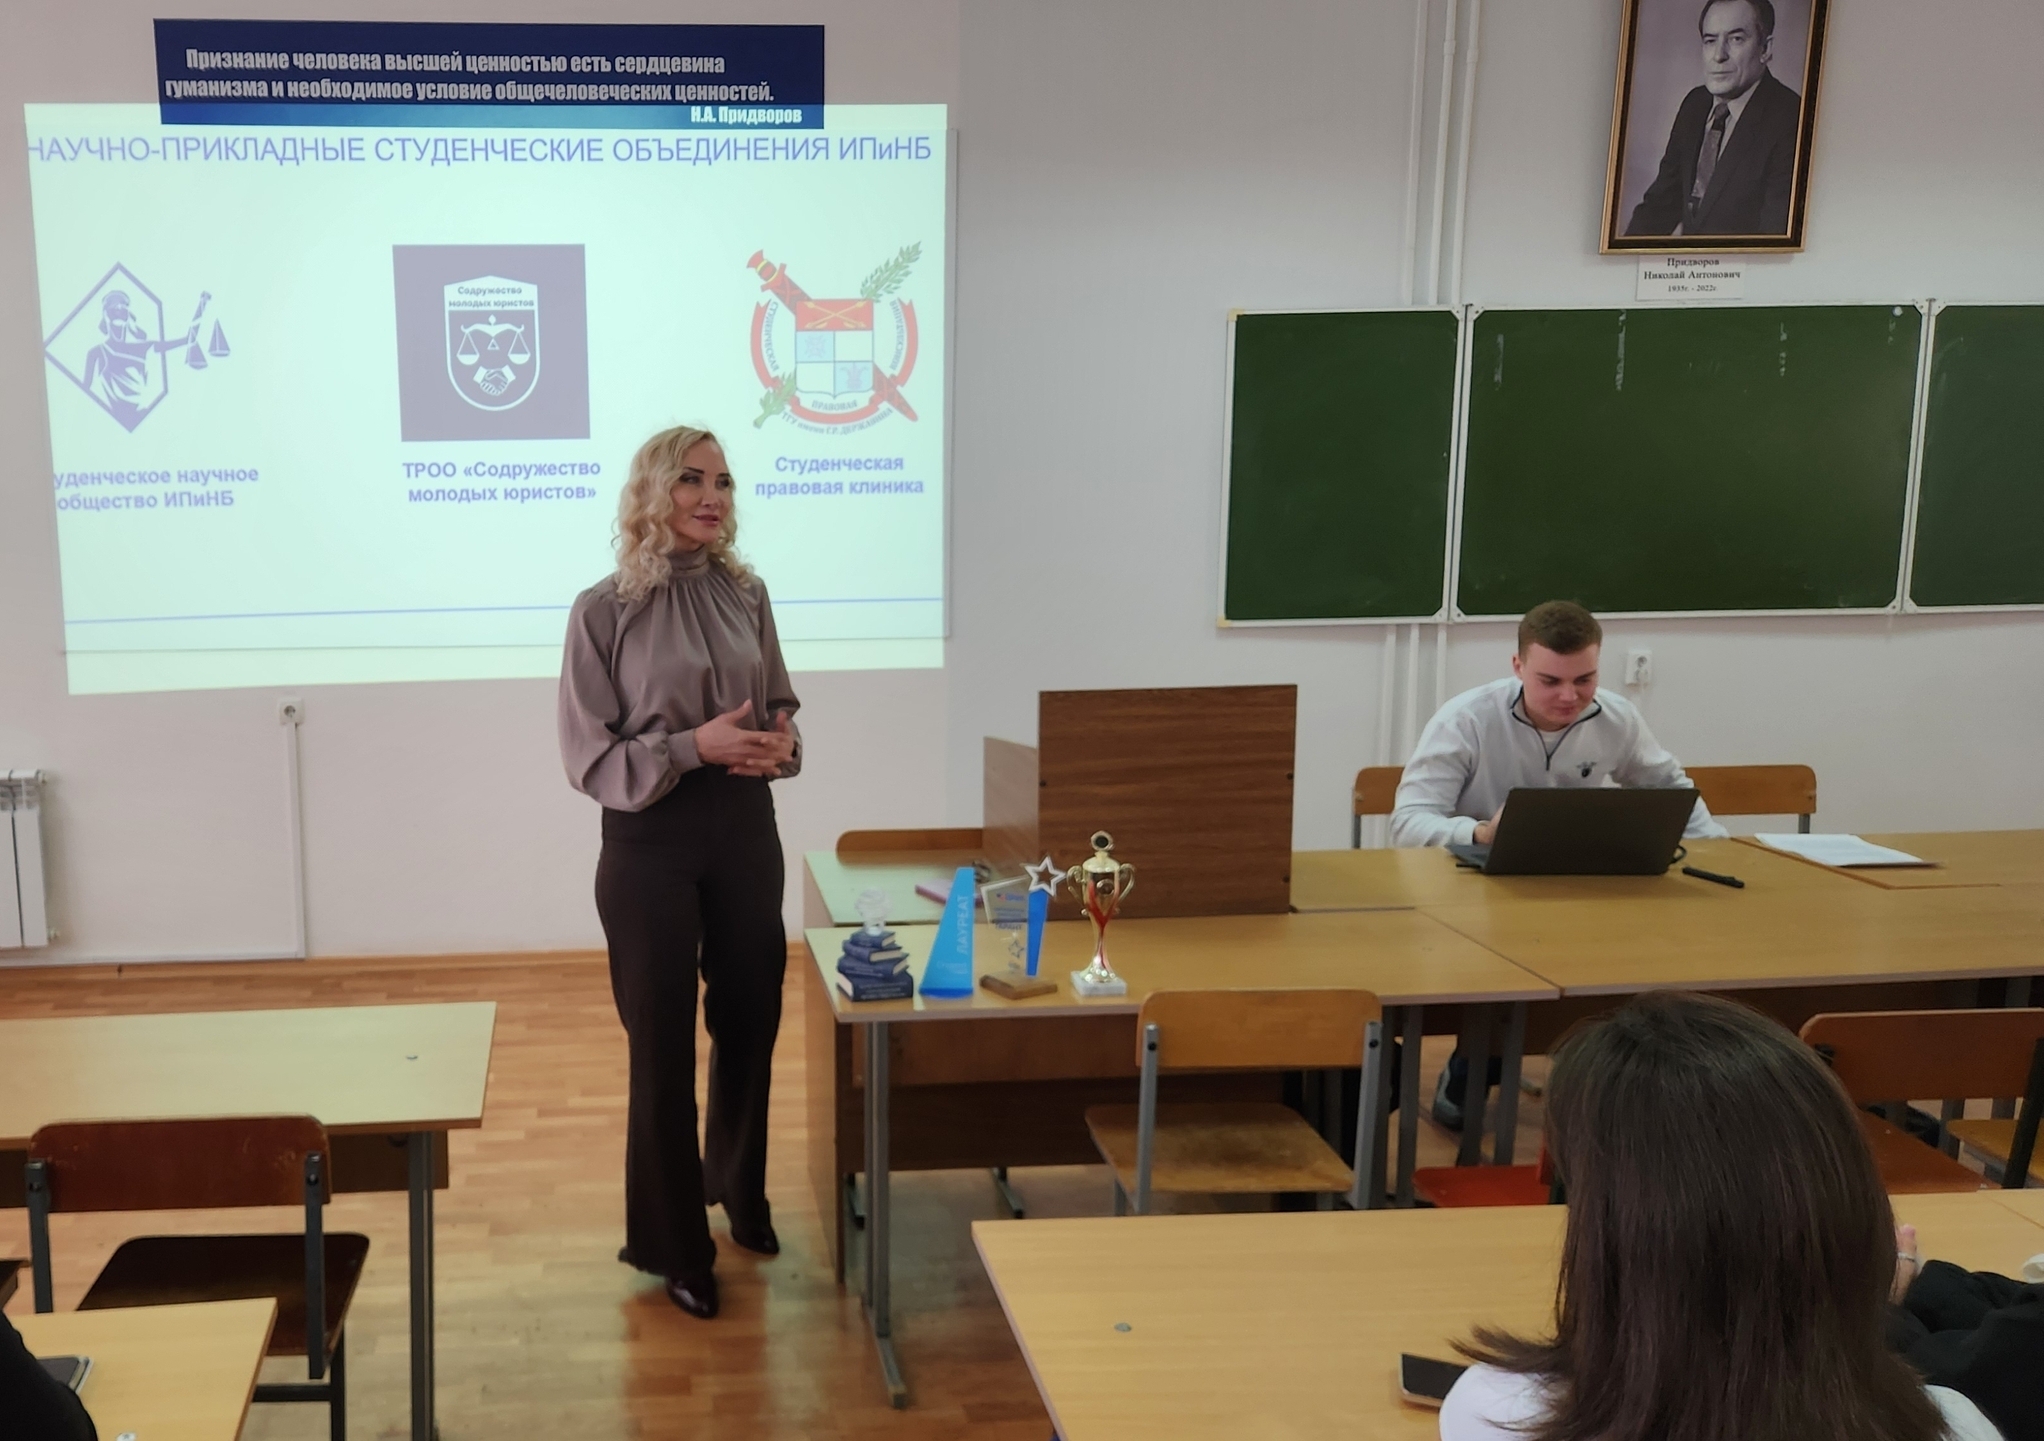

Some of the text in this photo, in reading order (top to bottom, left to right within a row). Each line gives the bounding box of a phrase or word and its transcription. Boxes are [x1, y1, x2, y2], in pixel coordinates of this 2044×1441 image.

[185, 48, 726, 76] Признание человека высшей ценностью есть сердцевина
[165, 77, 775, 103] гуманизма и необходимое условие общечеловеческих ценностей.
[690, 105, 803, 125] Н.А. Придворов
[27, 136, 932, 167] НАУЧНО-ПРИКЛАДНЫЕ СТУДЕНЧЕСКИЕ ОБЪЕДИНЕНИЯ ИПиНБ
[1667, 257, 1720, 268] Придворов
[1643, 271, 1741, 280] Николай Антонович
[457, 286, 523, 296] Содружество
[402, 461, 601, 481] ТРОО «Содружество
[775, 456, 904, 475] Студенческая
[177, 467, 259, 485] научное
[408, 485, 597, 504] молодых юристов»
[755, 480, 924, 499] правовая клиника
[56, 490, 234, 511] общество ИПиНБ
[956, 895, 971, 956] ЛАУРЕАТ
